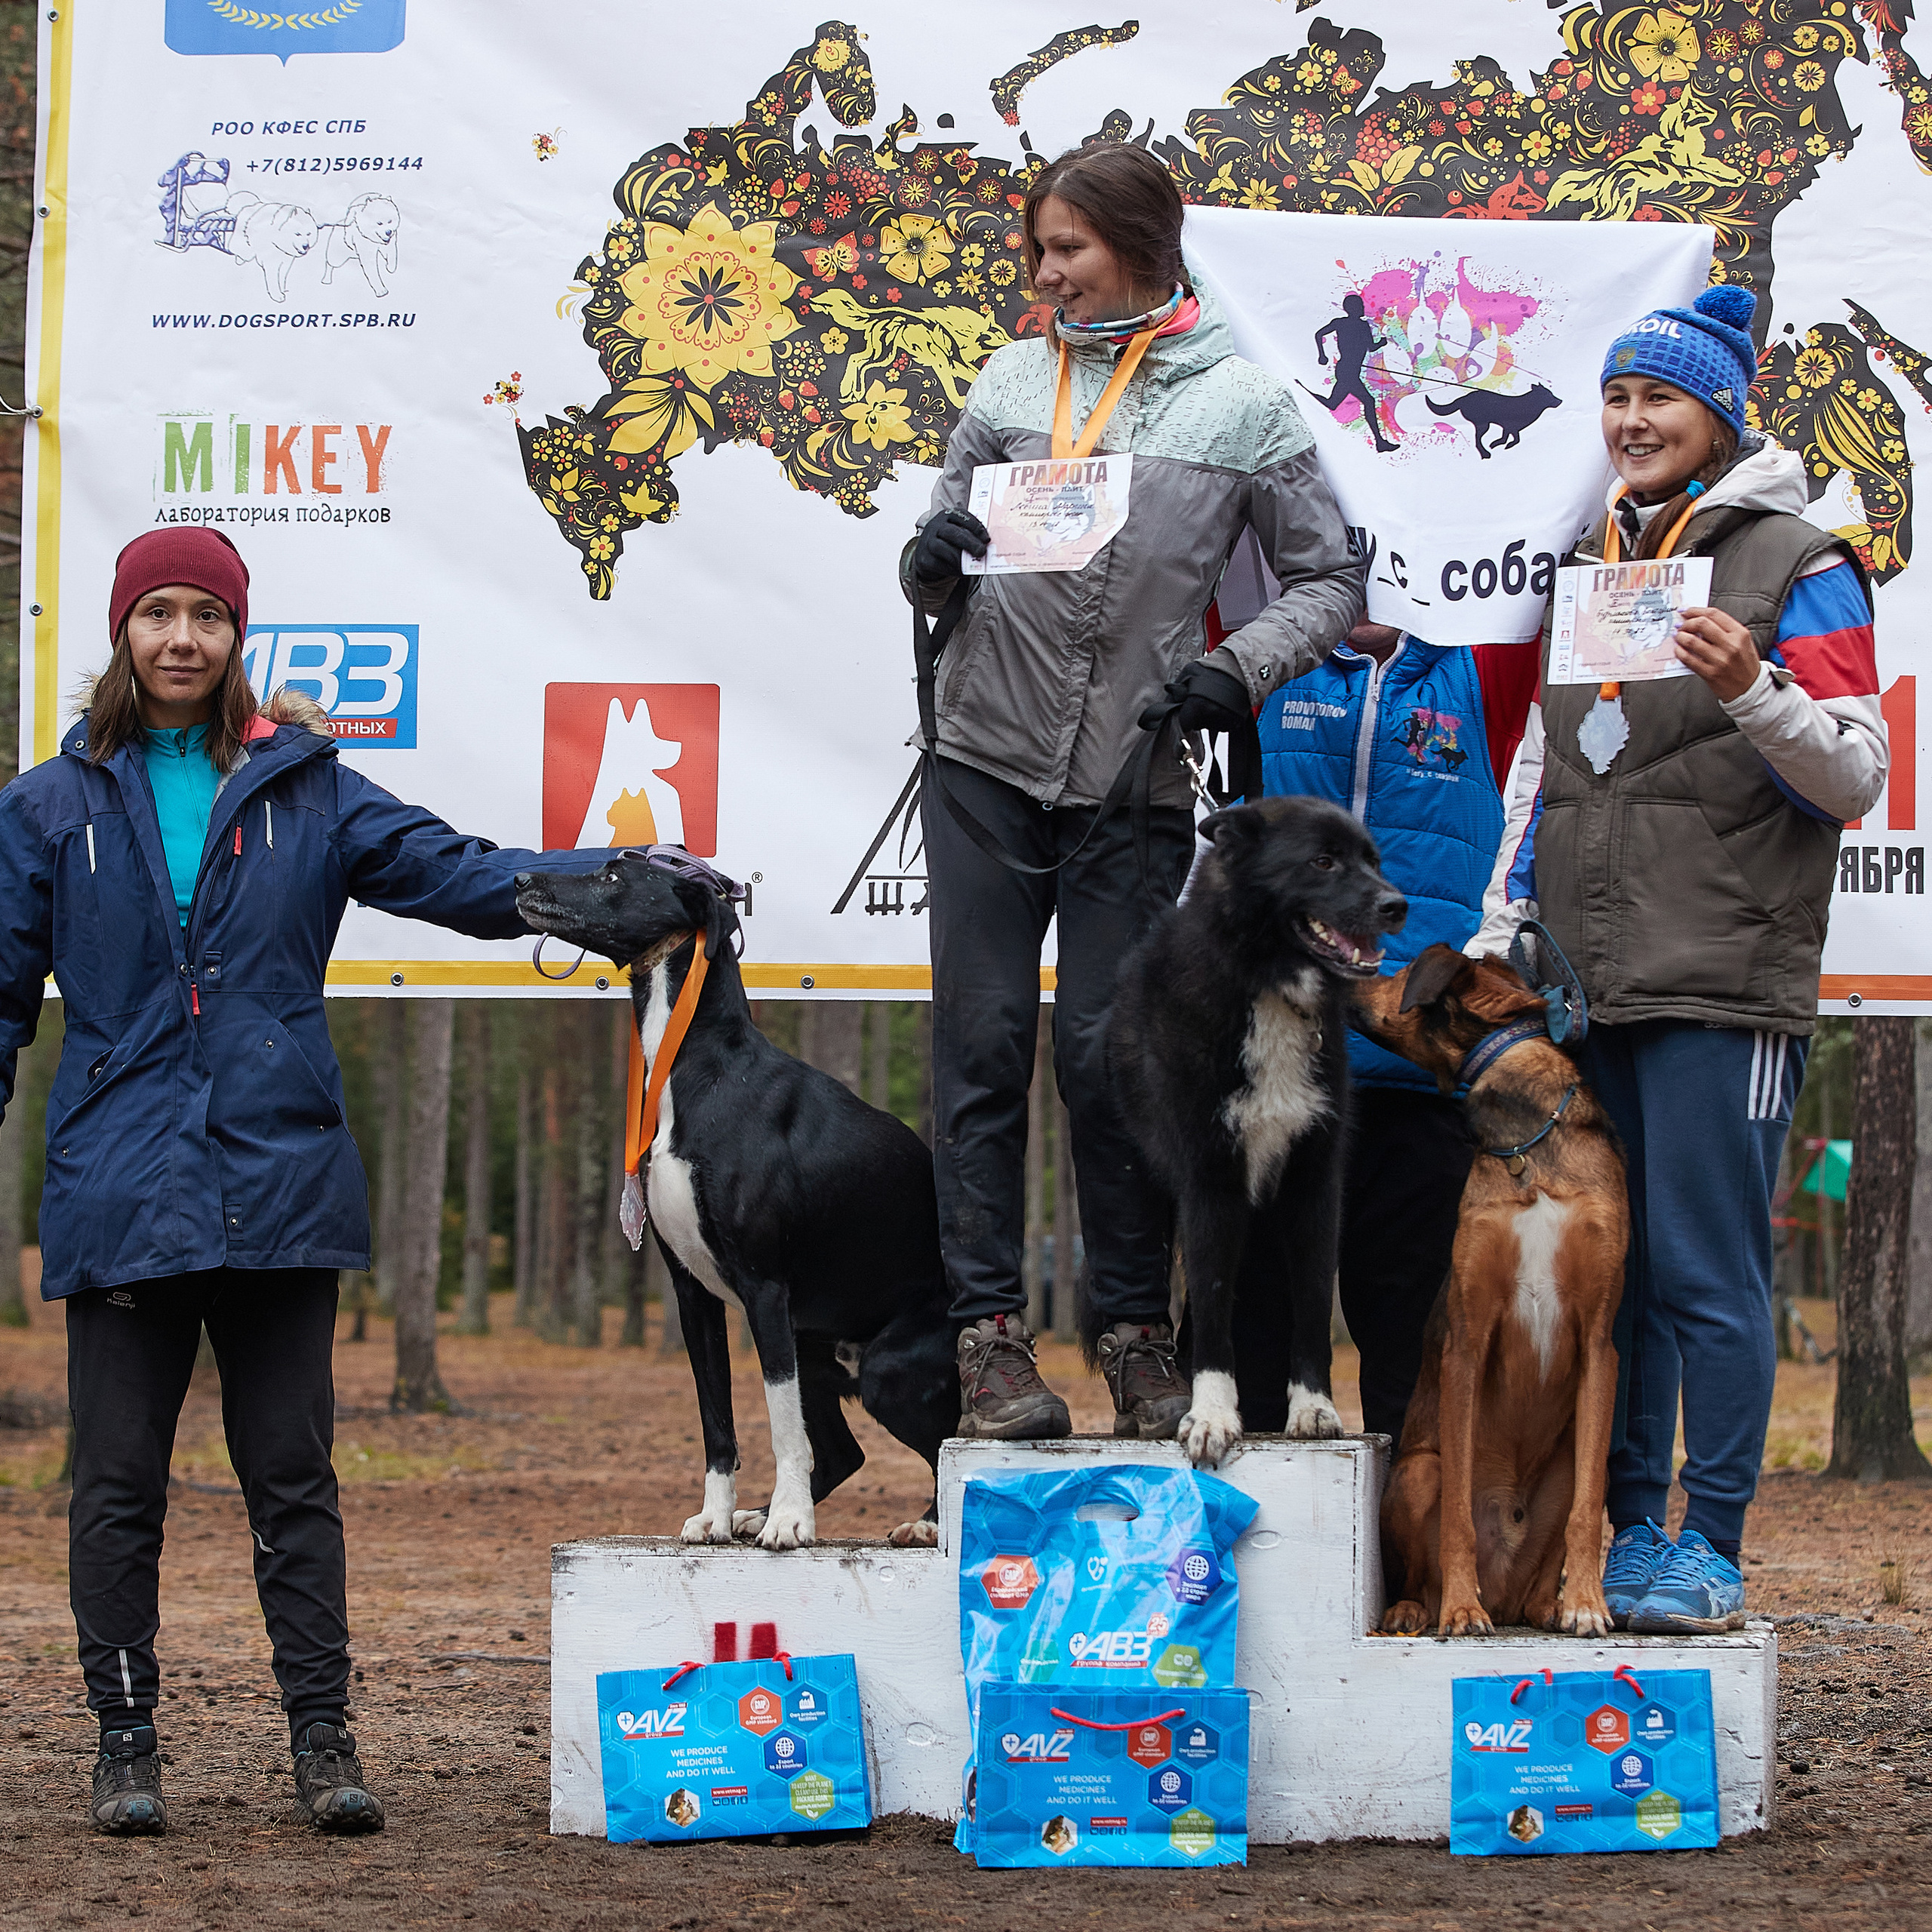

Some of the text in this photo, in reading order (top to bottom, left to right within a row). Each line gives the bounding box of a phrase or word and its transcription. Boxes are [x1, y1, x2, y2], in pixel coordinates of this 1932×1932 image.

[211, 119, 367, 135] РОО КФЕС СПБ
[246, 156, 423, 175] +7(812)5969144
[152, 312, 417, 328] WWW.DOGSPORT.SPB.RU
[1620, 318, 1681, 339] KOIL
[164, 421, 392, 494] MIKEY
[1009, 462, 1107, 487] ГРАМОТА
[155, 503, 391, 527] лаборатория подарков
[1593, 563, 1684, 592] ГРАМОТА
[325, 721, 386, 734] ОТНЫХ
[1281, 715, 1315, 731] ROMAN
[1839, 845, 1924, 894] ЯБРЯ
[1149, 1617, 1168, 1631] 25
[1077, 1632, 1153, 1660] АВЗ
[627, 1708, 688, 1734] AVZ
[1474, 1724, 1533, 1747] AVZ
[671, 1746, 728, 1757] WE PRODUCE
[1011, 1734, 1074, 1757] AVZ
[677, 1757, 723, 1767] MEDICINES
[1531, 1764, 1573, 1773] PRODUCE
[666, 1770, 685, 1778] AND
[711, 1767, 735, 1775] WELL
[1069, 1775, 1112, 1783] PRODUCE
[1521, 1775, 1568, 1783] MEDICINES
[1531, 1786, 1544, 1794] DO
[1068, 1796, 1081, 1804] DO
[1093, 1796, 1118, 1804] WELL
